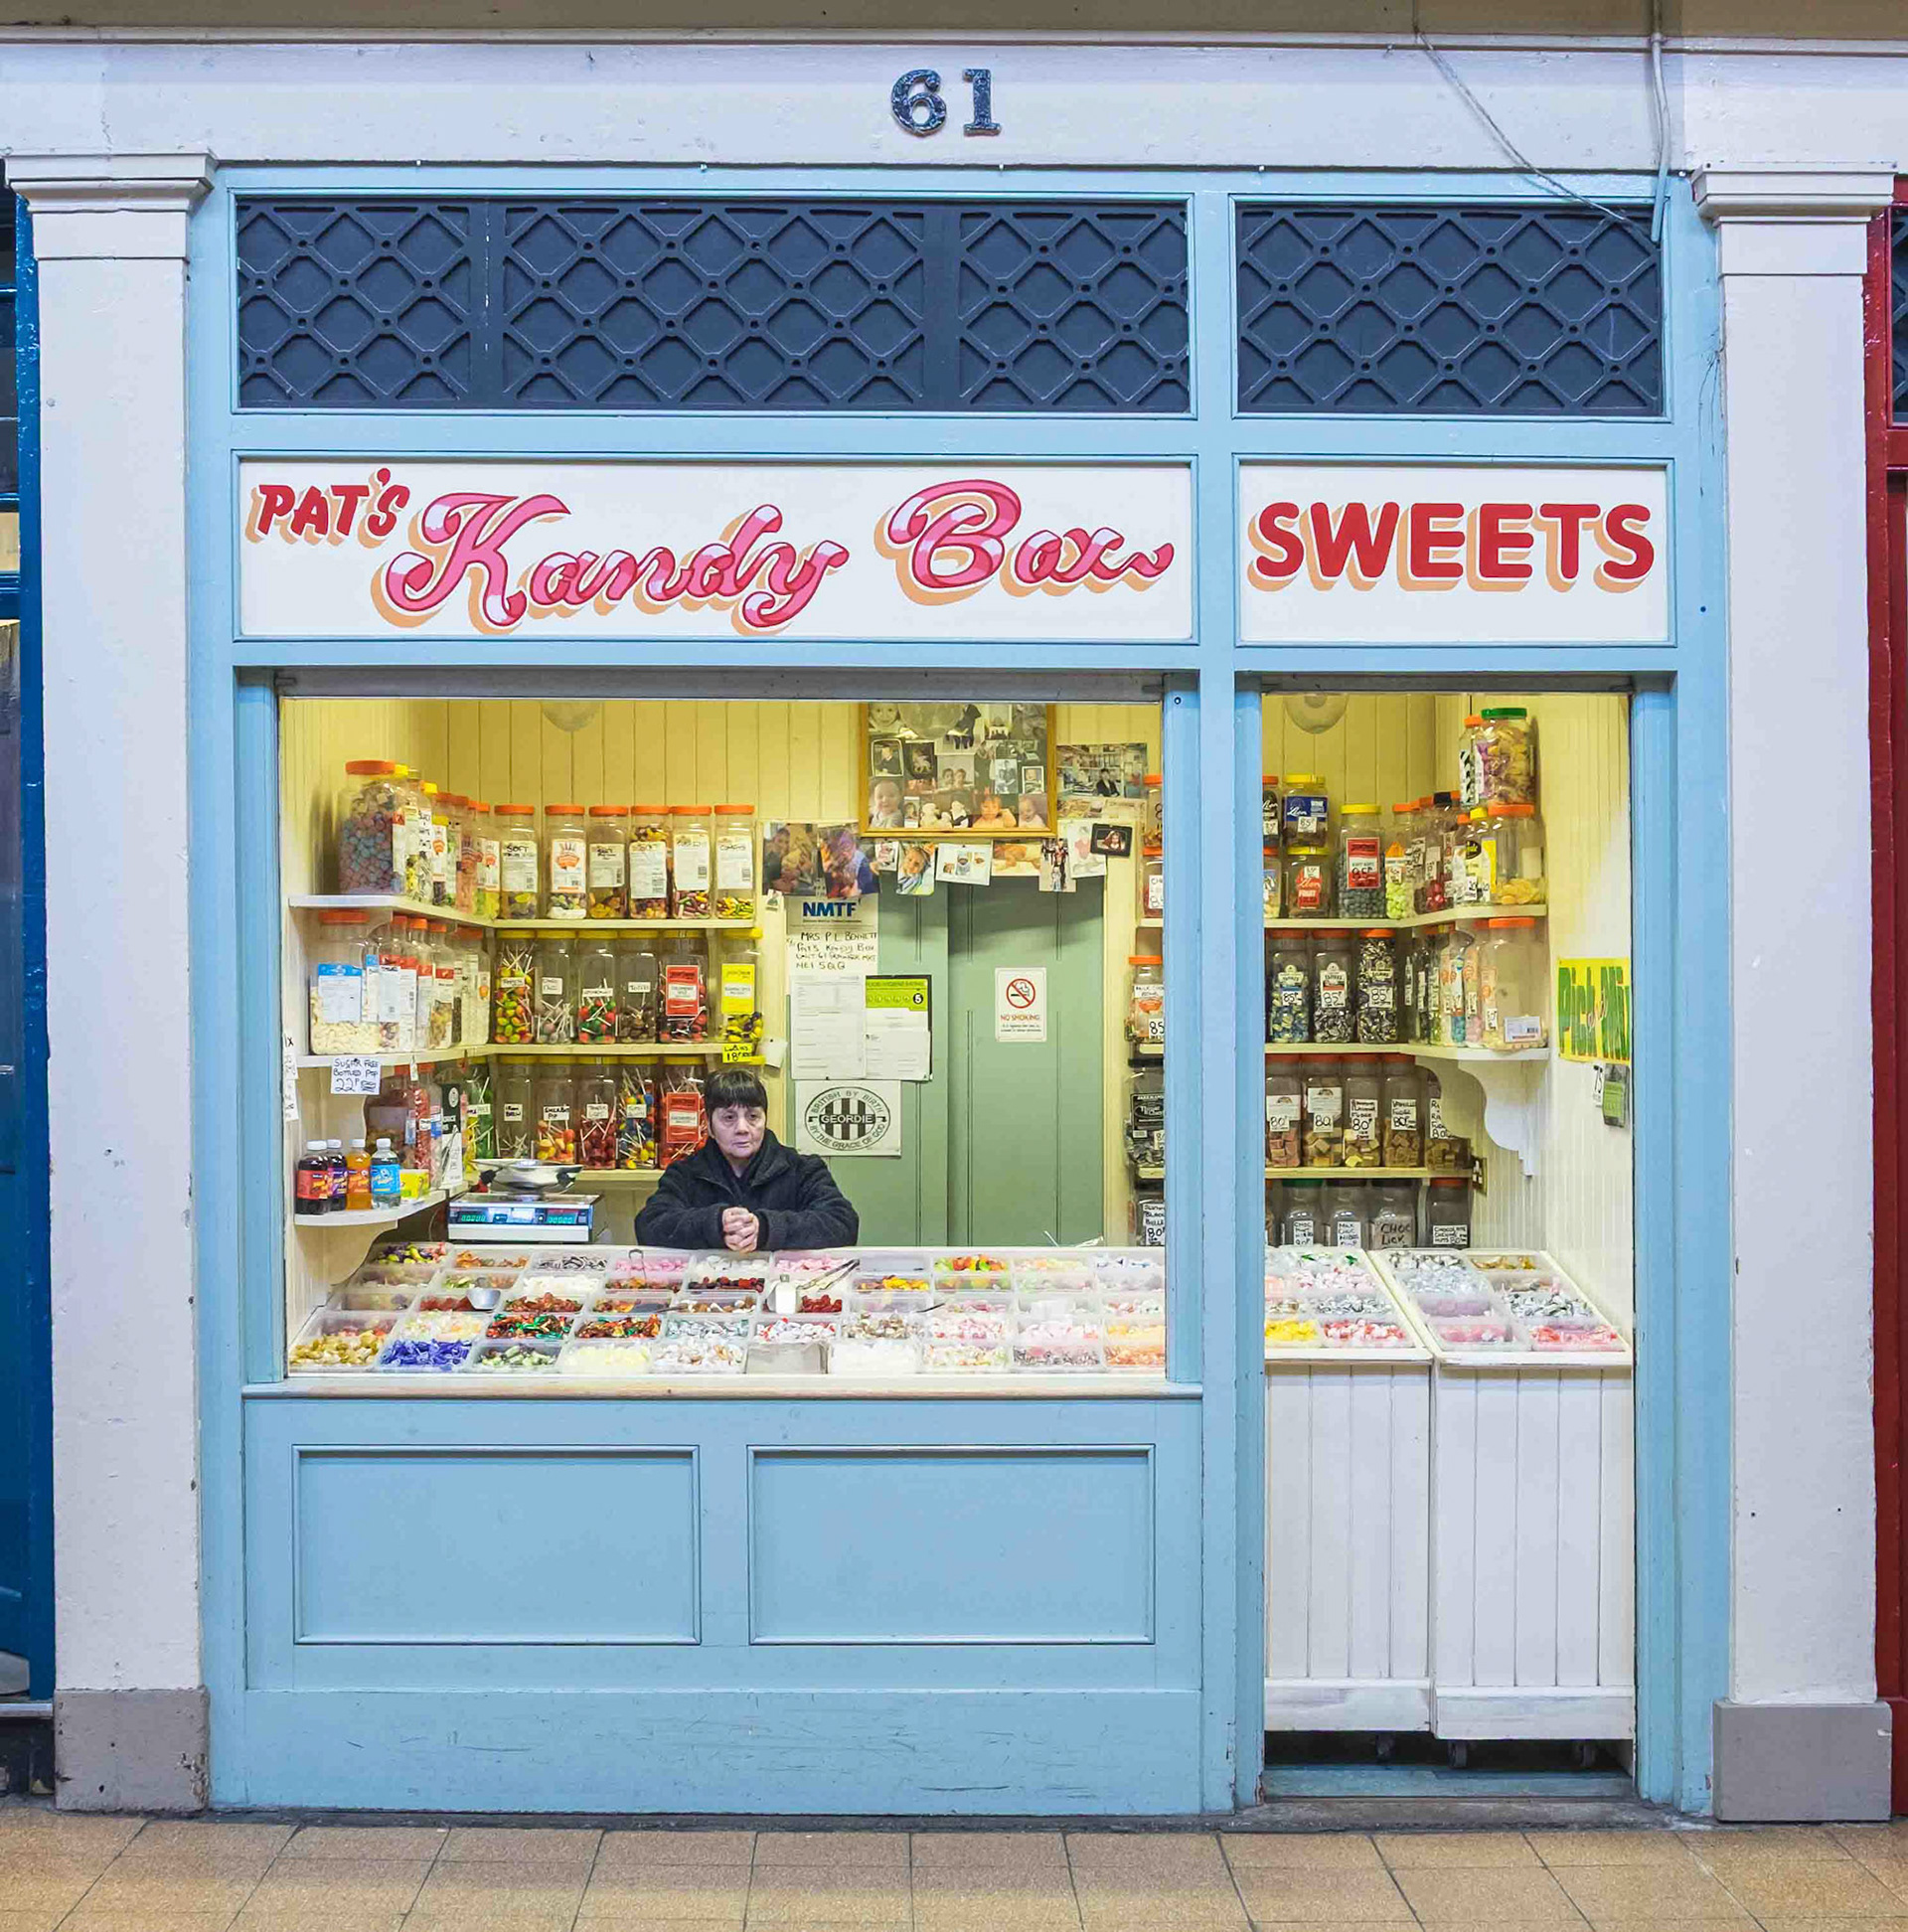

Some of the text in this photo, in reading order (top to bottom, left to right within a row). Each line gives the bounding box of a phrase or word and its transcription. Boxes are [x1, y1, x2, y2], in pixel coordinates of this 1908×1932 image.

[891, 69, 1002, 137] 61
[248, 468, 1175, 633] PAT'S Kandy Box
[1250, 502, 1655, 593] SWEETS
[803, 902, 857, 916] NMTF
[800, 932, 821, 941] MRS
[825, 931, 832, 941] P
[334, 1058, 364, 1068] SUGAR
[811, 1091, 842, 1113] BRITISH
[862, 1094, 883, 1113] BIRTH
[821, 1115, 874, 1124] GEORDIE
[816, 1133, 832, 1145] THE
[832, 1140, 861, 1149] GRACE
[862, 1136, 873, 1145] OF
[873, 1123, 885, 1138] GOD
[1381, 1222, 1410, 1233] CHOC
